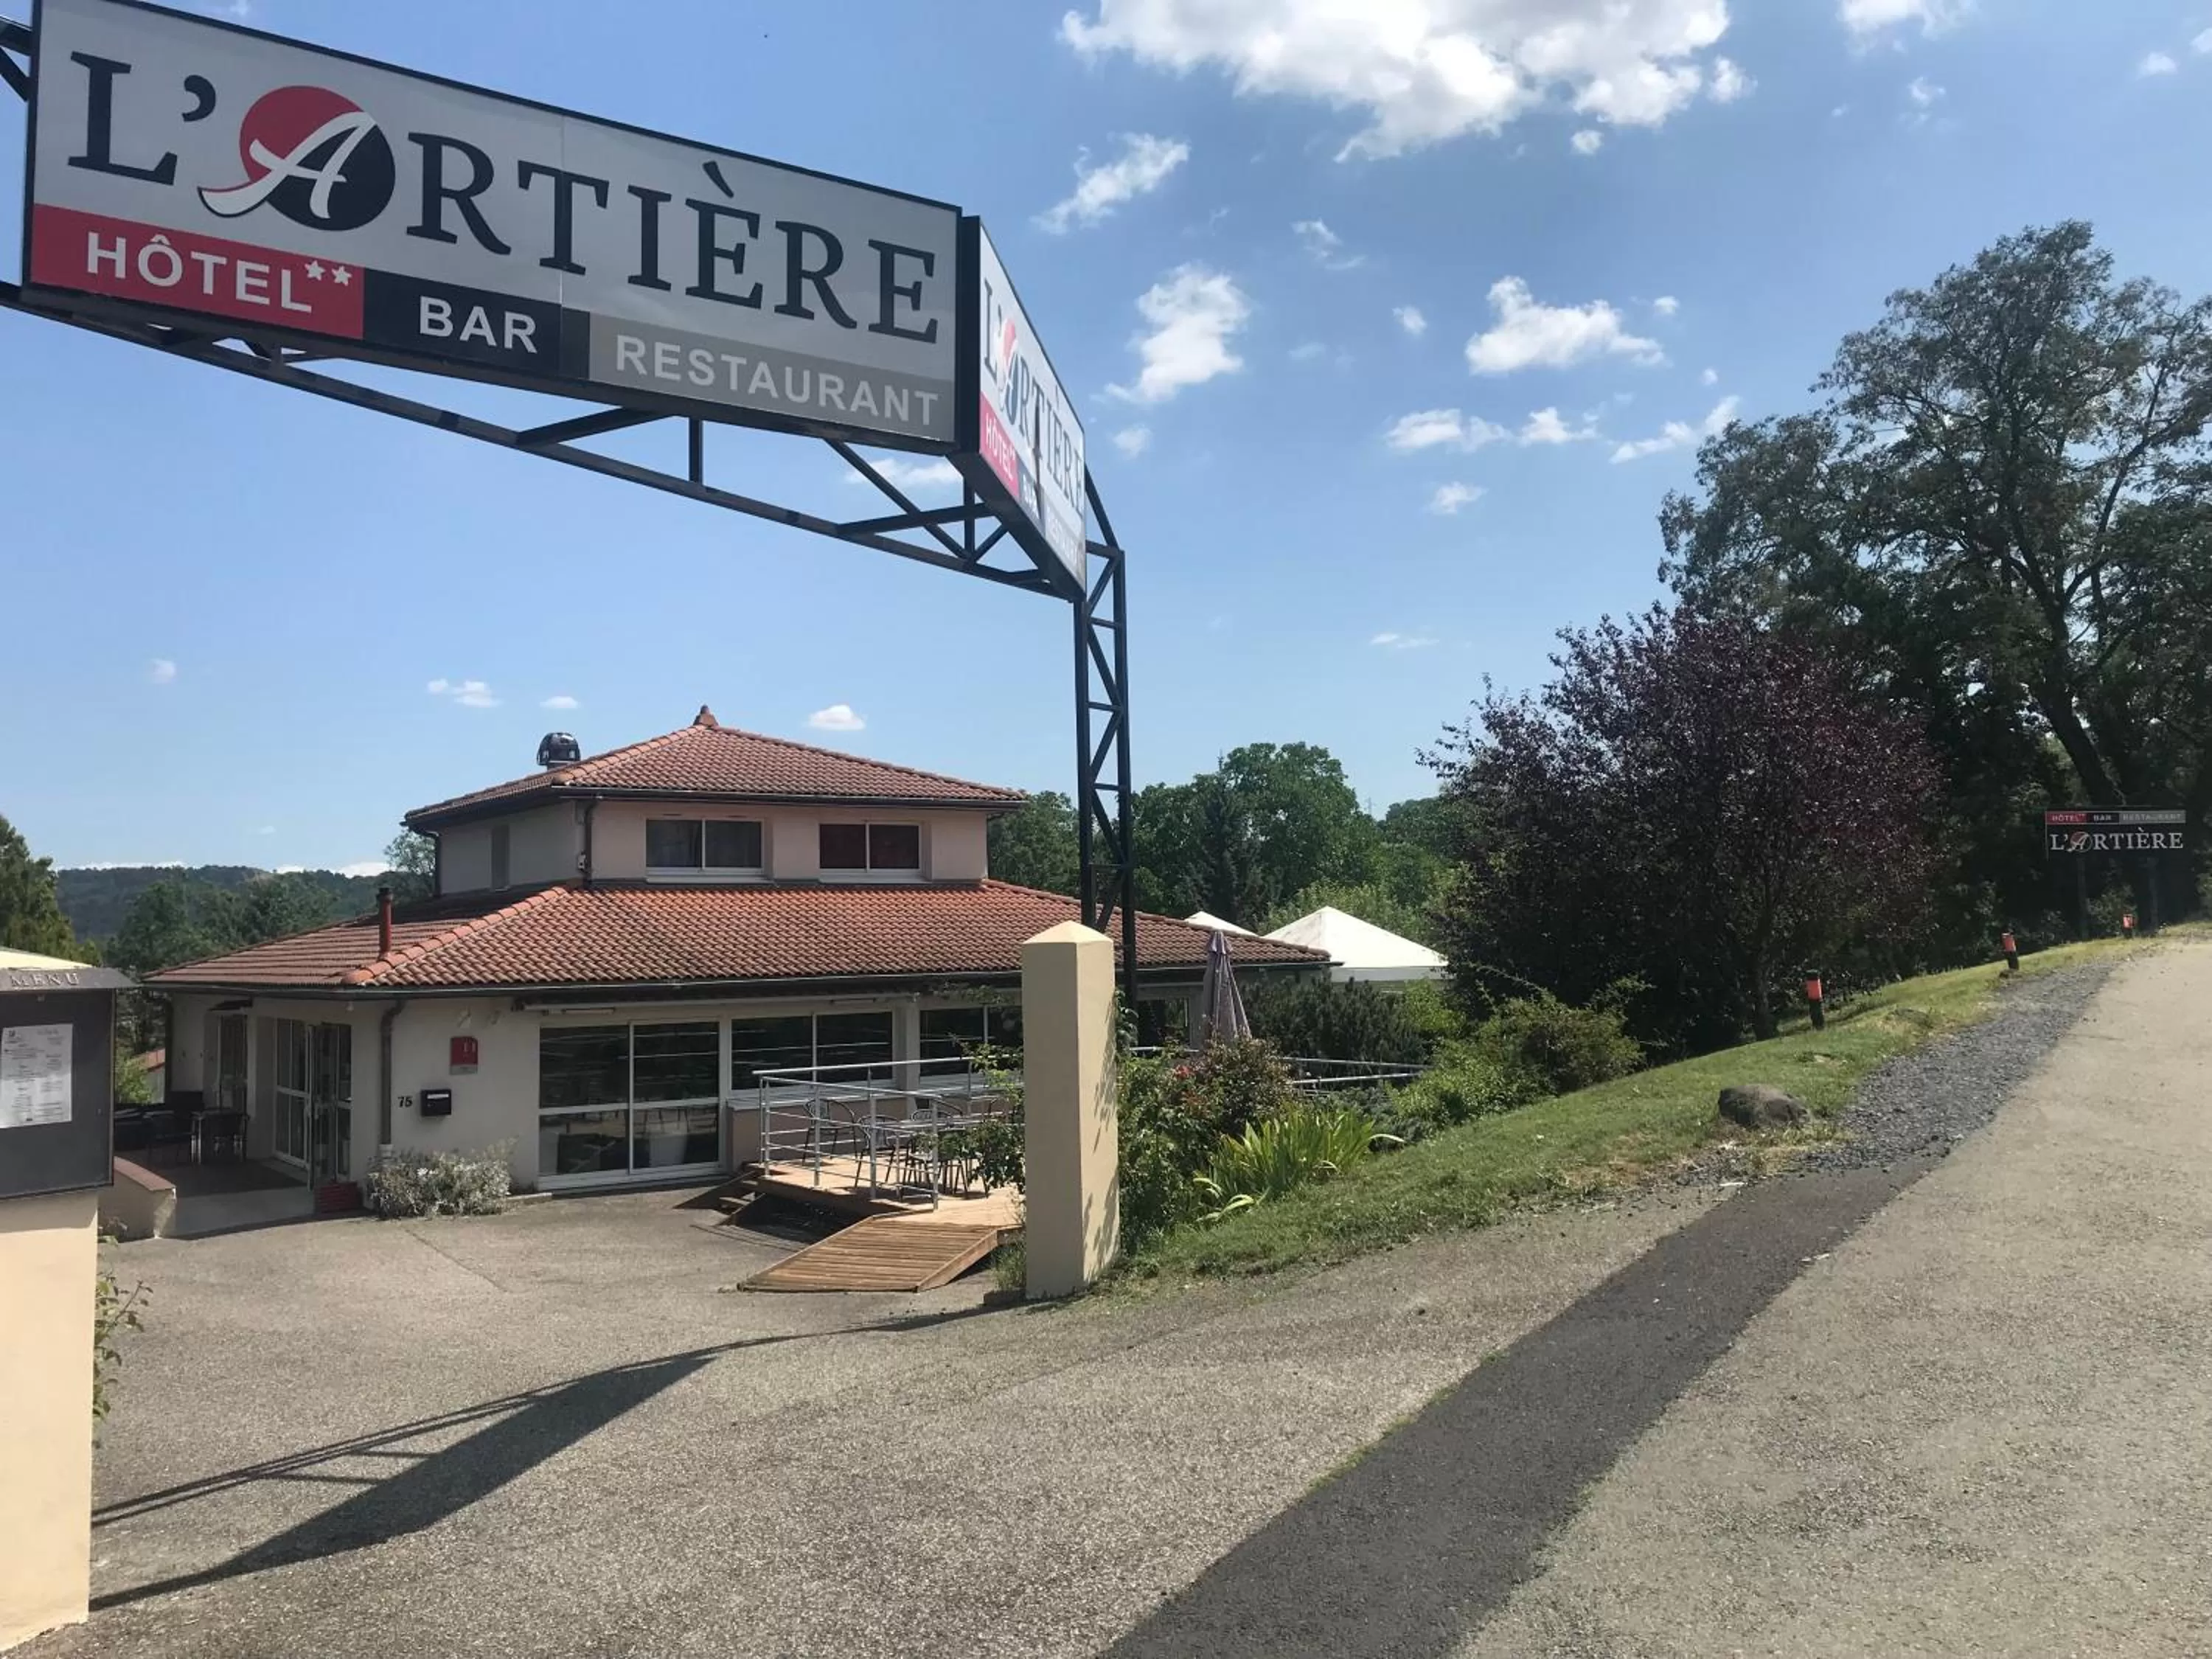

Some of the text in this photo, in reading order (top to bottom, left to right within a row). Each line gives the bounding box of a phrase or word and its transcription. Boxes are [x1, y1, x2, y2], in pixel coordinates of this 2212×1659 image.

[68, 50, 939, 344] L'ARTIÈRE
[86, 231, 313, 314] HÔTEL
[419, 296, 538, 354] BAR
[616, 334, 939, 426] RESTAURANT
[985, 411, 1015, 482] HÔTEL
[2050, 826, 2184, 853] L'ARTIÈRE
[10, 973, 80, 987] MENU
